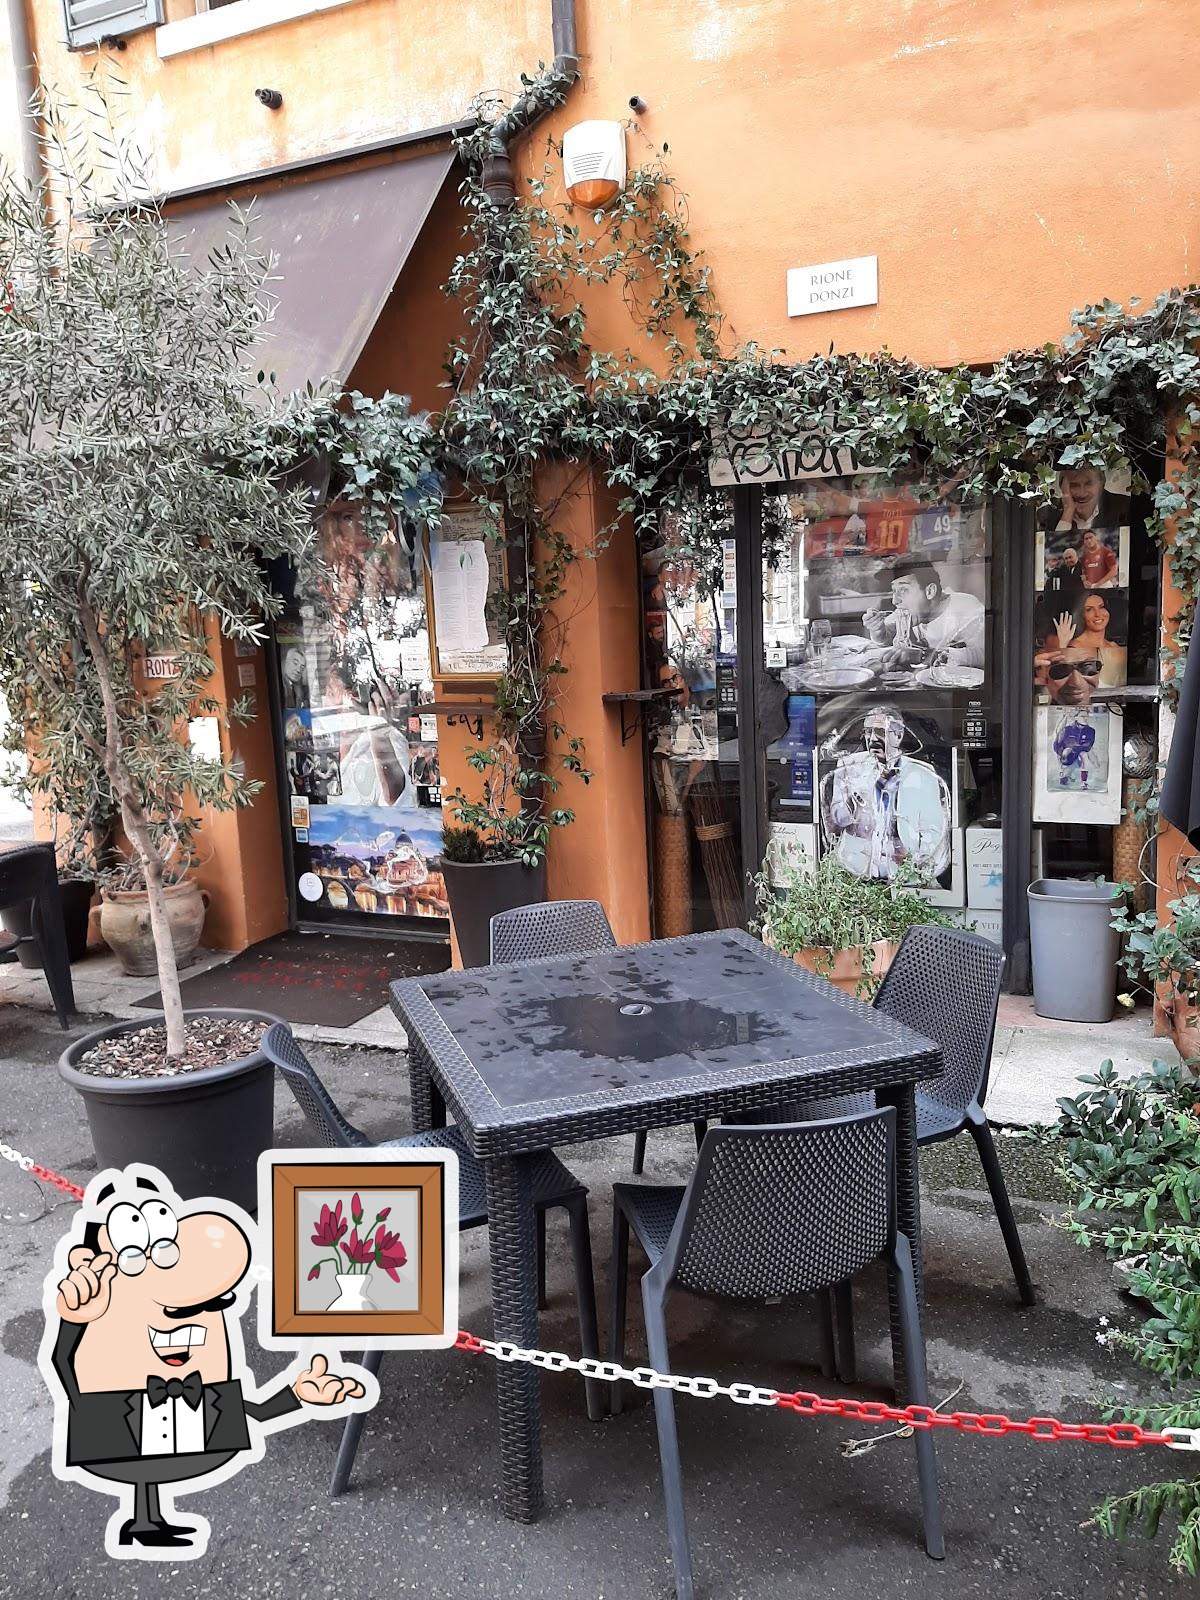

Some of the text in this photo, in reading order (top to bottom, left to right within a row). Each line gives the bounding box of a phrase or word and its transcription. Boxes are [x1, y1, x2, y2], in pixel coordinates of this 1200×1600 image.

[811, 269, 853, 286] RIONE
[810, 286, 853, 303] DONZI
[934, 514, 950, 534] 49
[879, 519, 904, 549] 10
